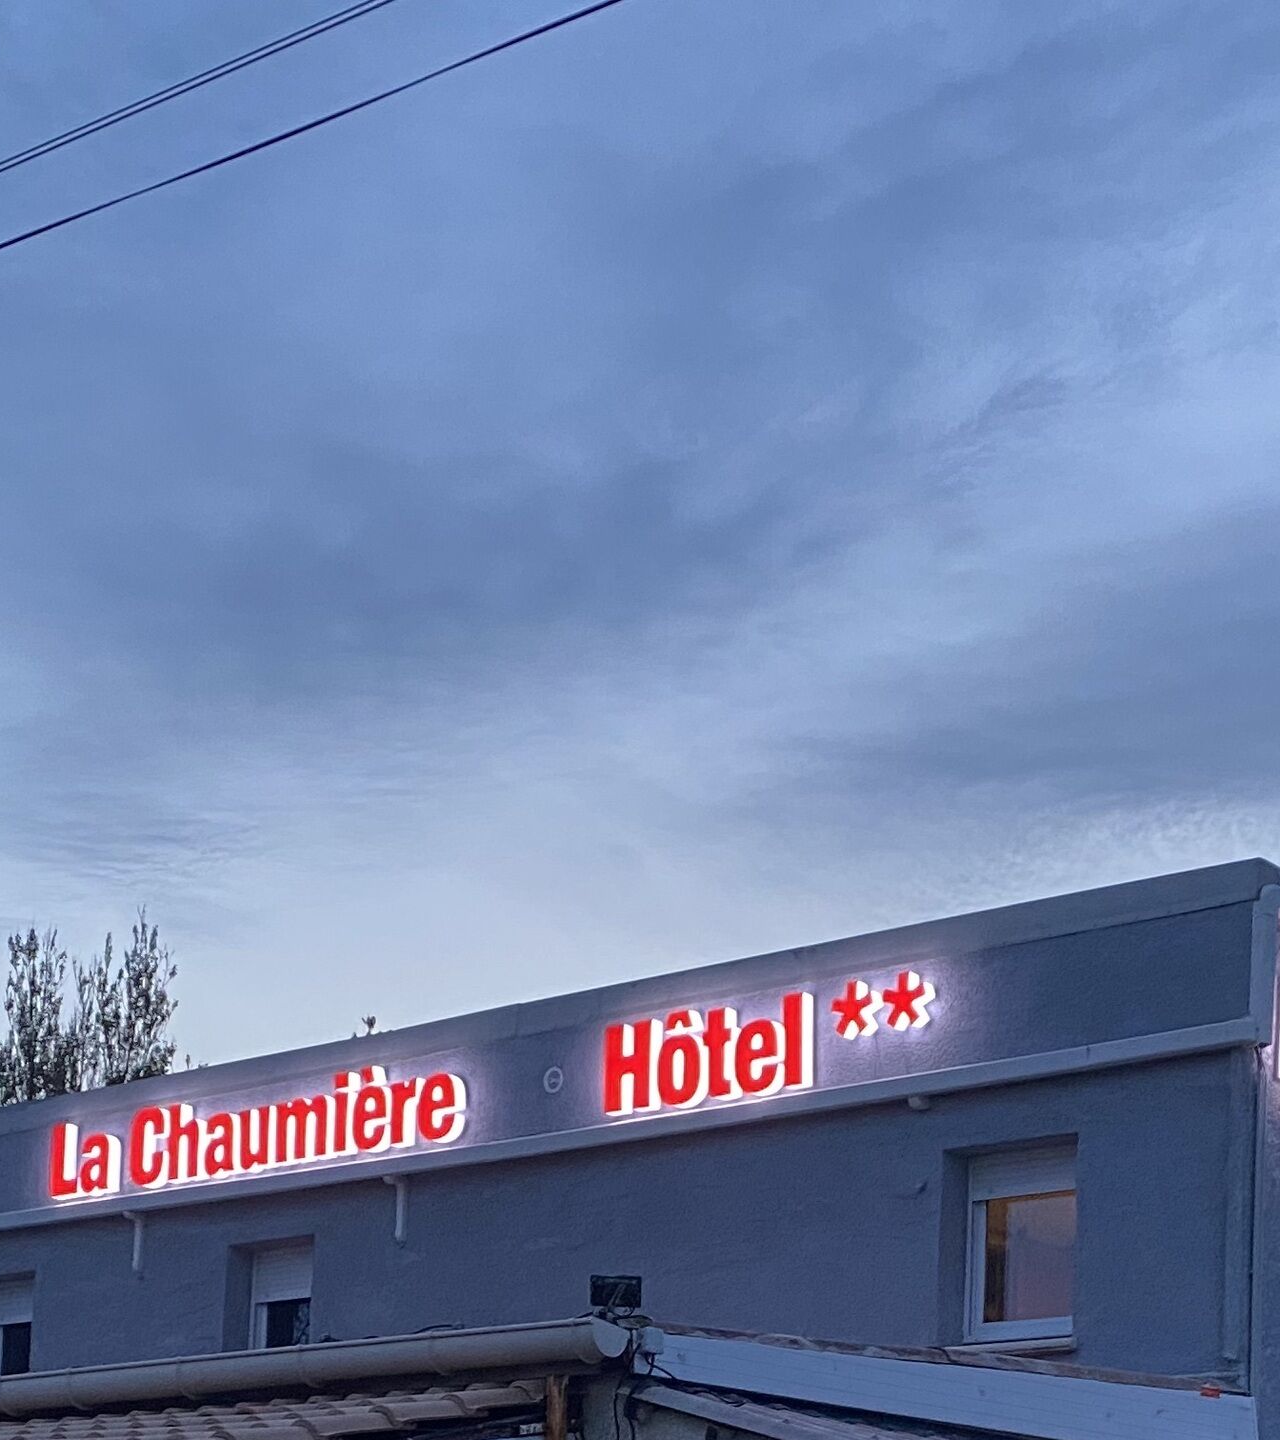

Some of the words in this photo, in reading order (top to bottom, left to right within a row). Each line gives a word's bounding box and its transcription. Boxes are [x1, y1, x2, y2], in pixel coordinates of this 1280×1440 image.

[603, 992, 810, 1114] Hôtel
[49, 1122, 118, 1198] La
[130, 1065, 463, 1188] Chaumière
